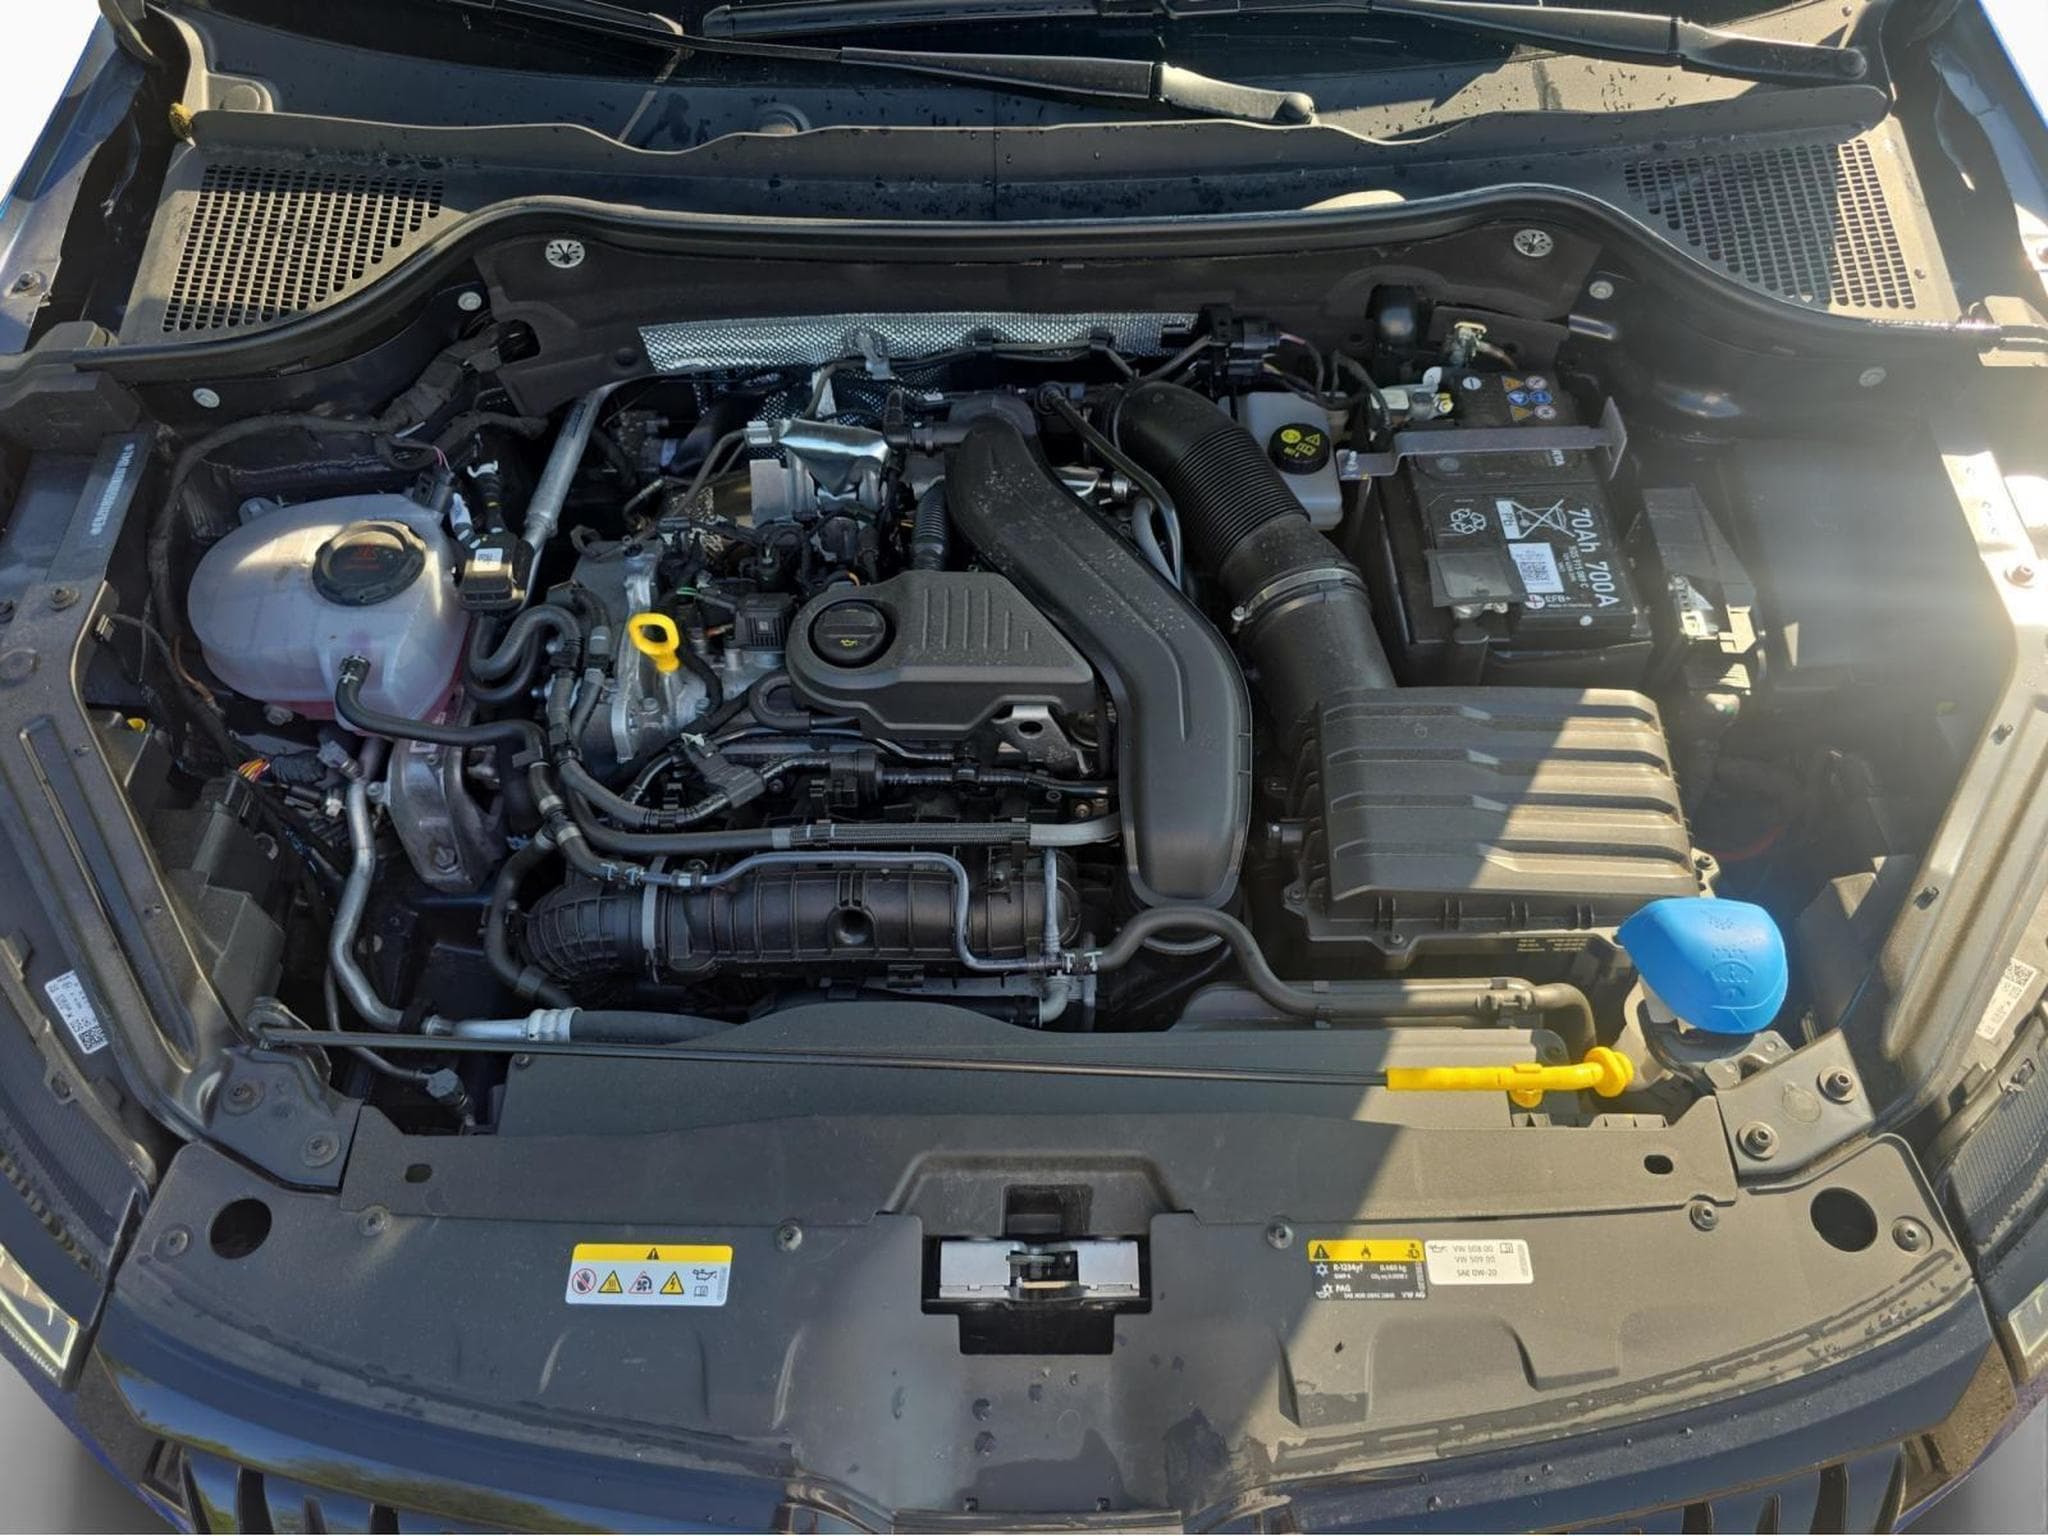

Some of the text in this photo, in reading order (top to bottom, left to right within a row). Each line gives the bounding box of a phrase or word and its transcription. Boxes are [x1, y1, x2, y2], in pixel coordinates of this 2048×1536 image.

[1568, 508, 1601, 552] 70Ah
[1584, 561, 1620, 607] 700A
[1335, 1283, 1351, 1293] PAG
[1400, 1291, 1414, 1299] VW
